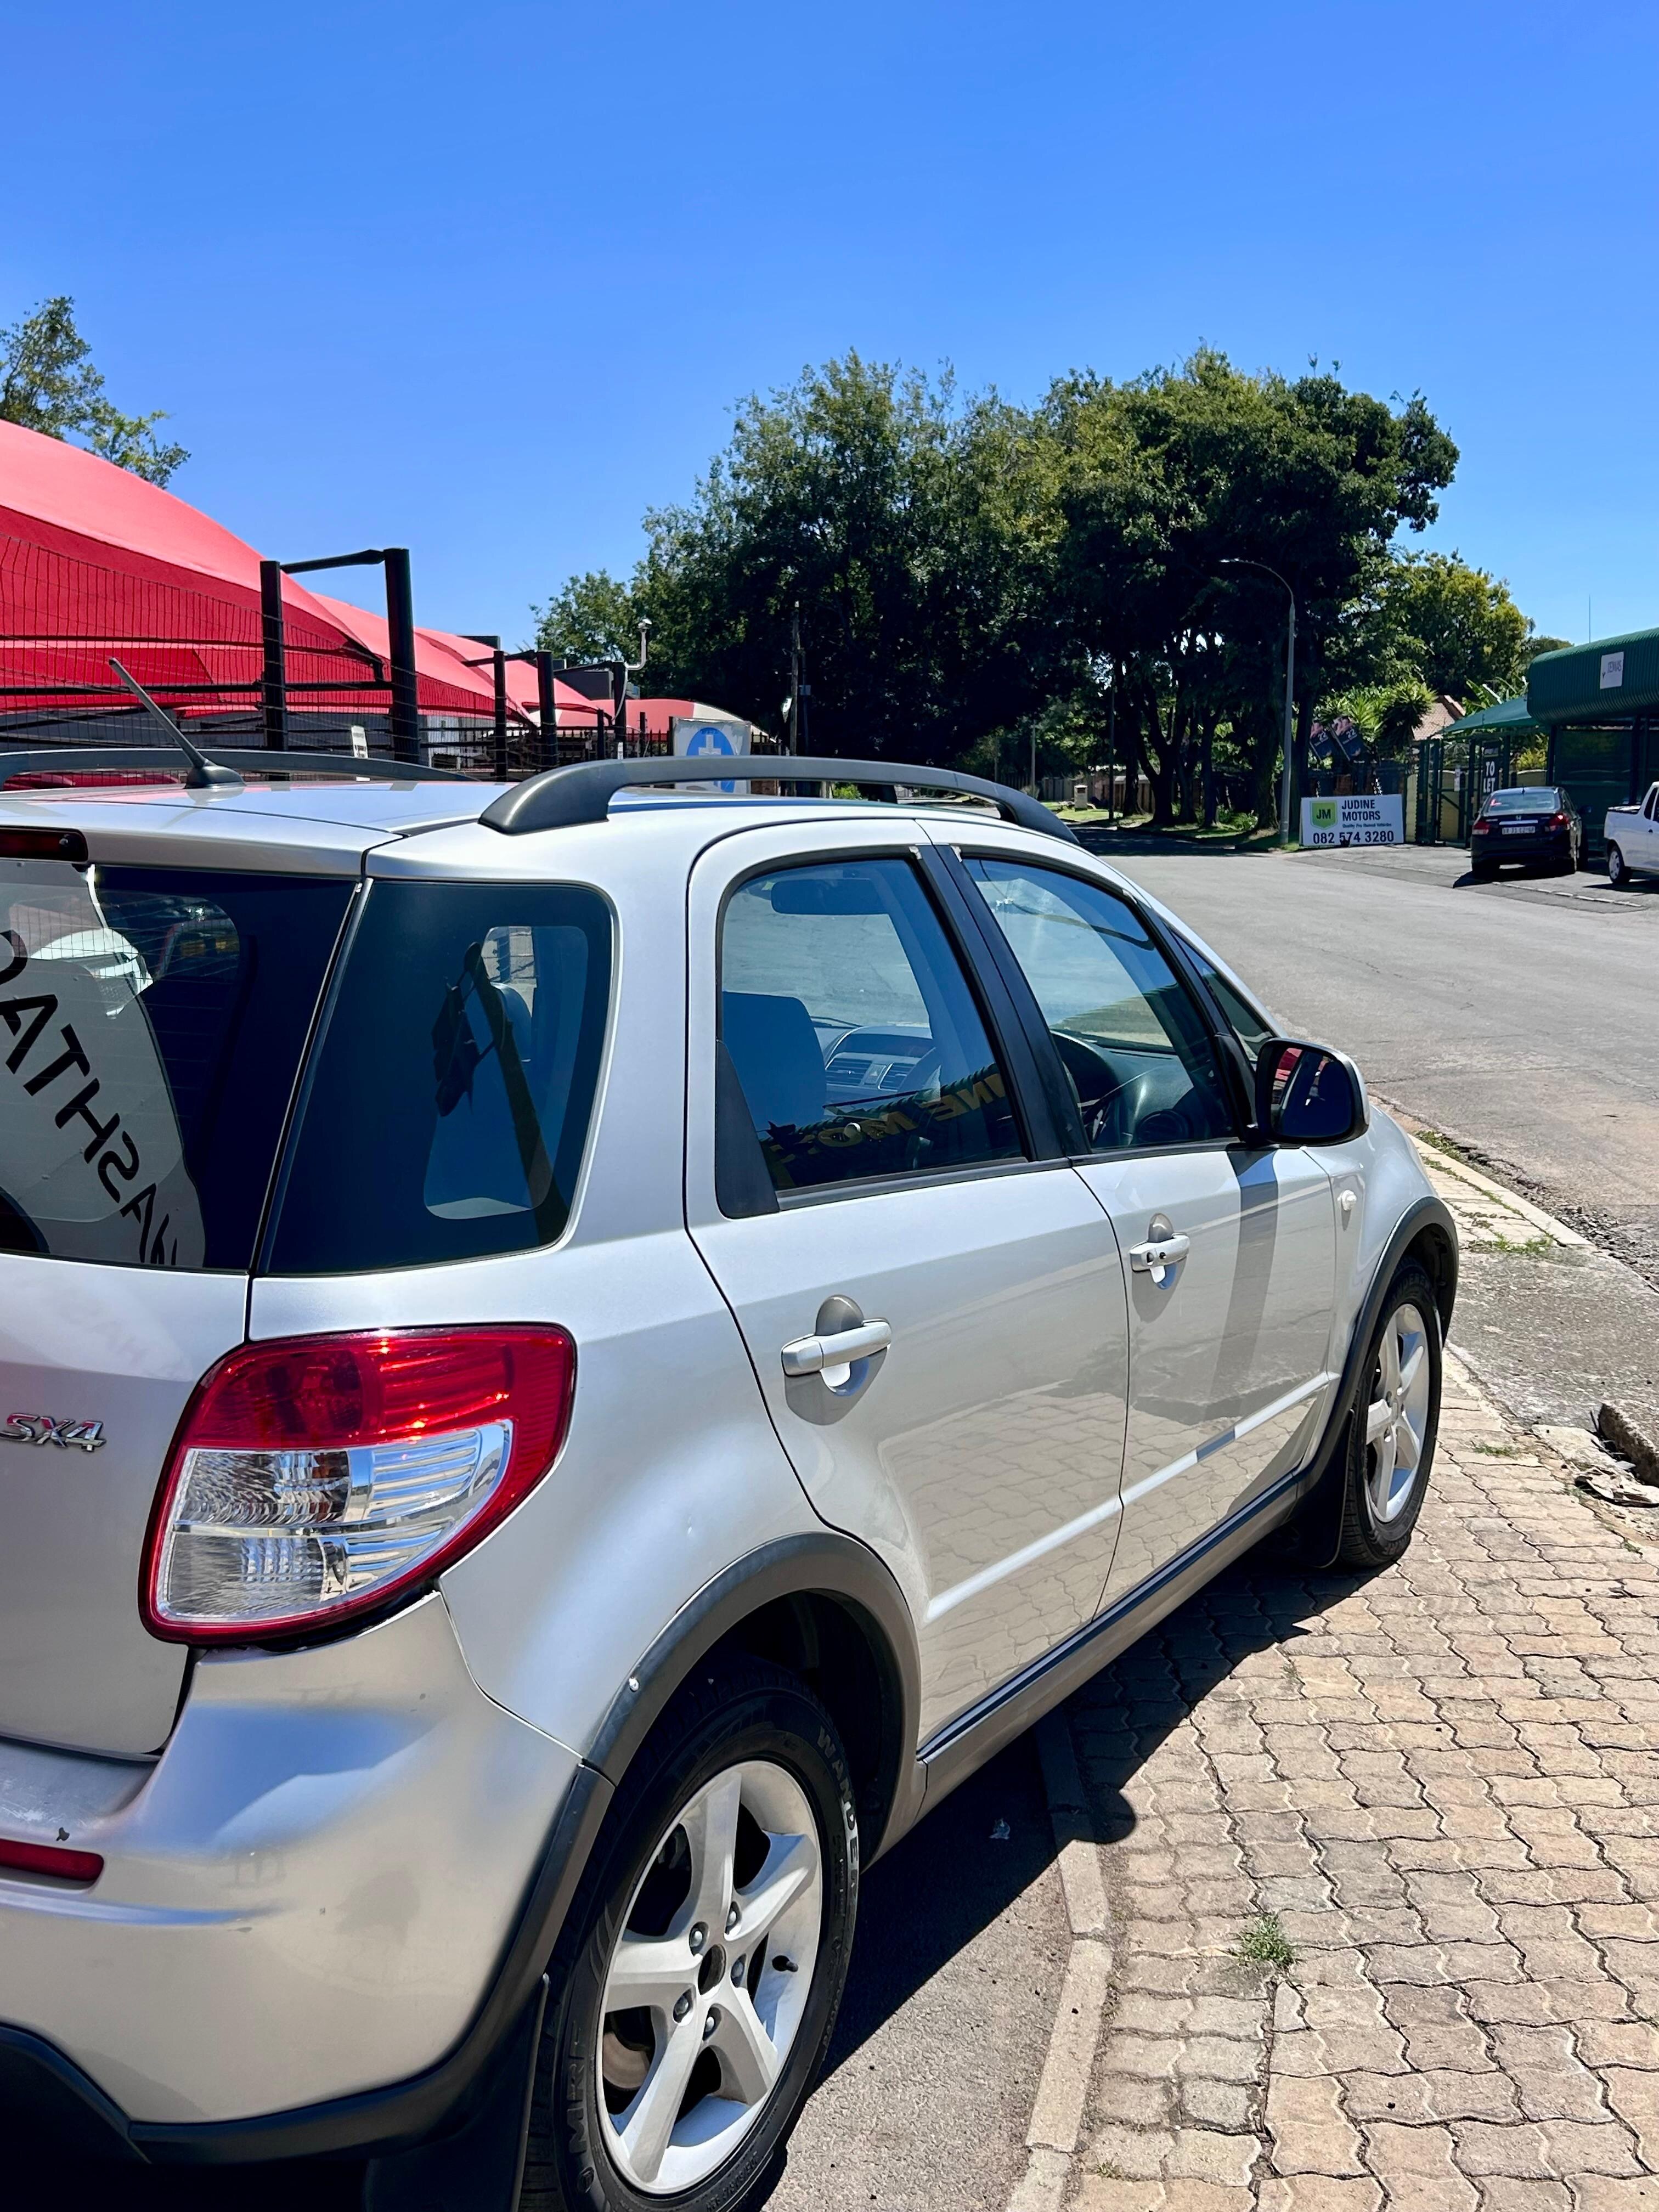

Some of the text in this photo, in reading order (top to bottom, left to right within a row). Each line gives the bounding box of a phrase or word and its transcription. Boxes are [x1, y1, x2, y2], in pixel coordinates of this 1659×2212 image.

[1486, 761, 1495, 776] TO
[1483, 777, 1496, 793] LET
[1341, 799, 1375, 810] JUDINE
[1317, 809, 1331, 819] JM
[1342, 811, 1381, 821] MOTORS
[1313, 831, 1394, 844] 082 574 3280
[0, 1412, 107, 1452] SX4
